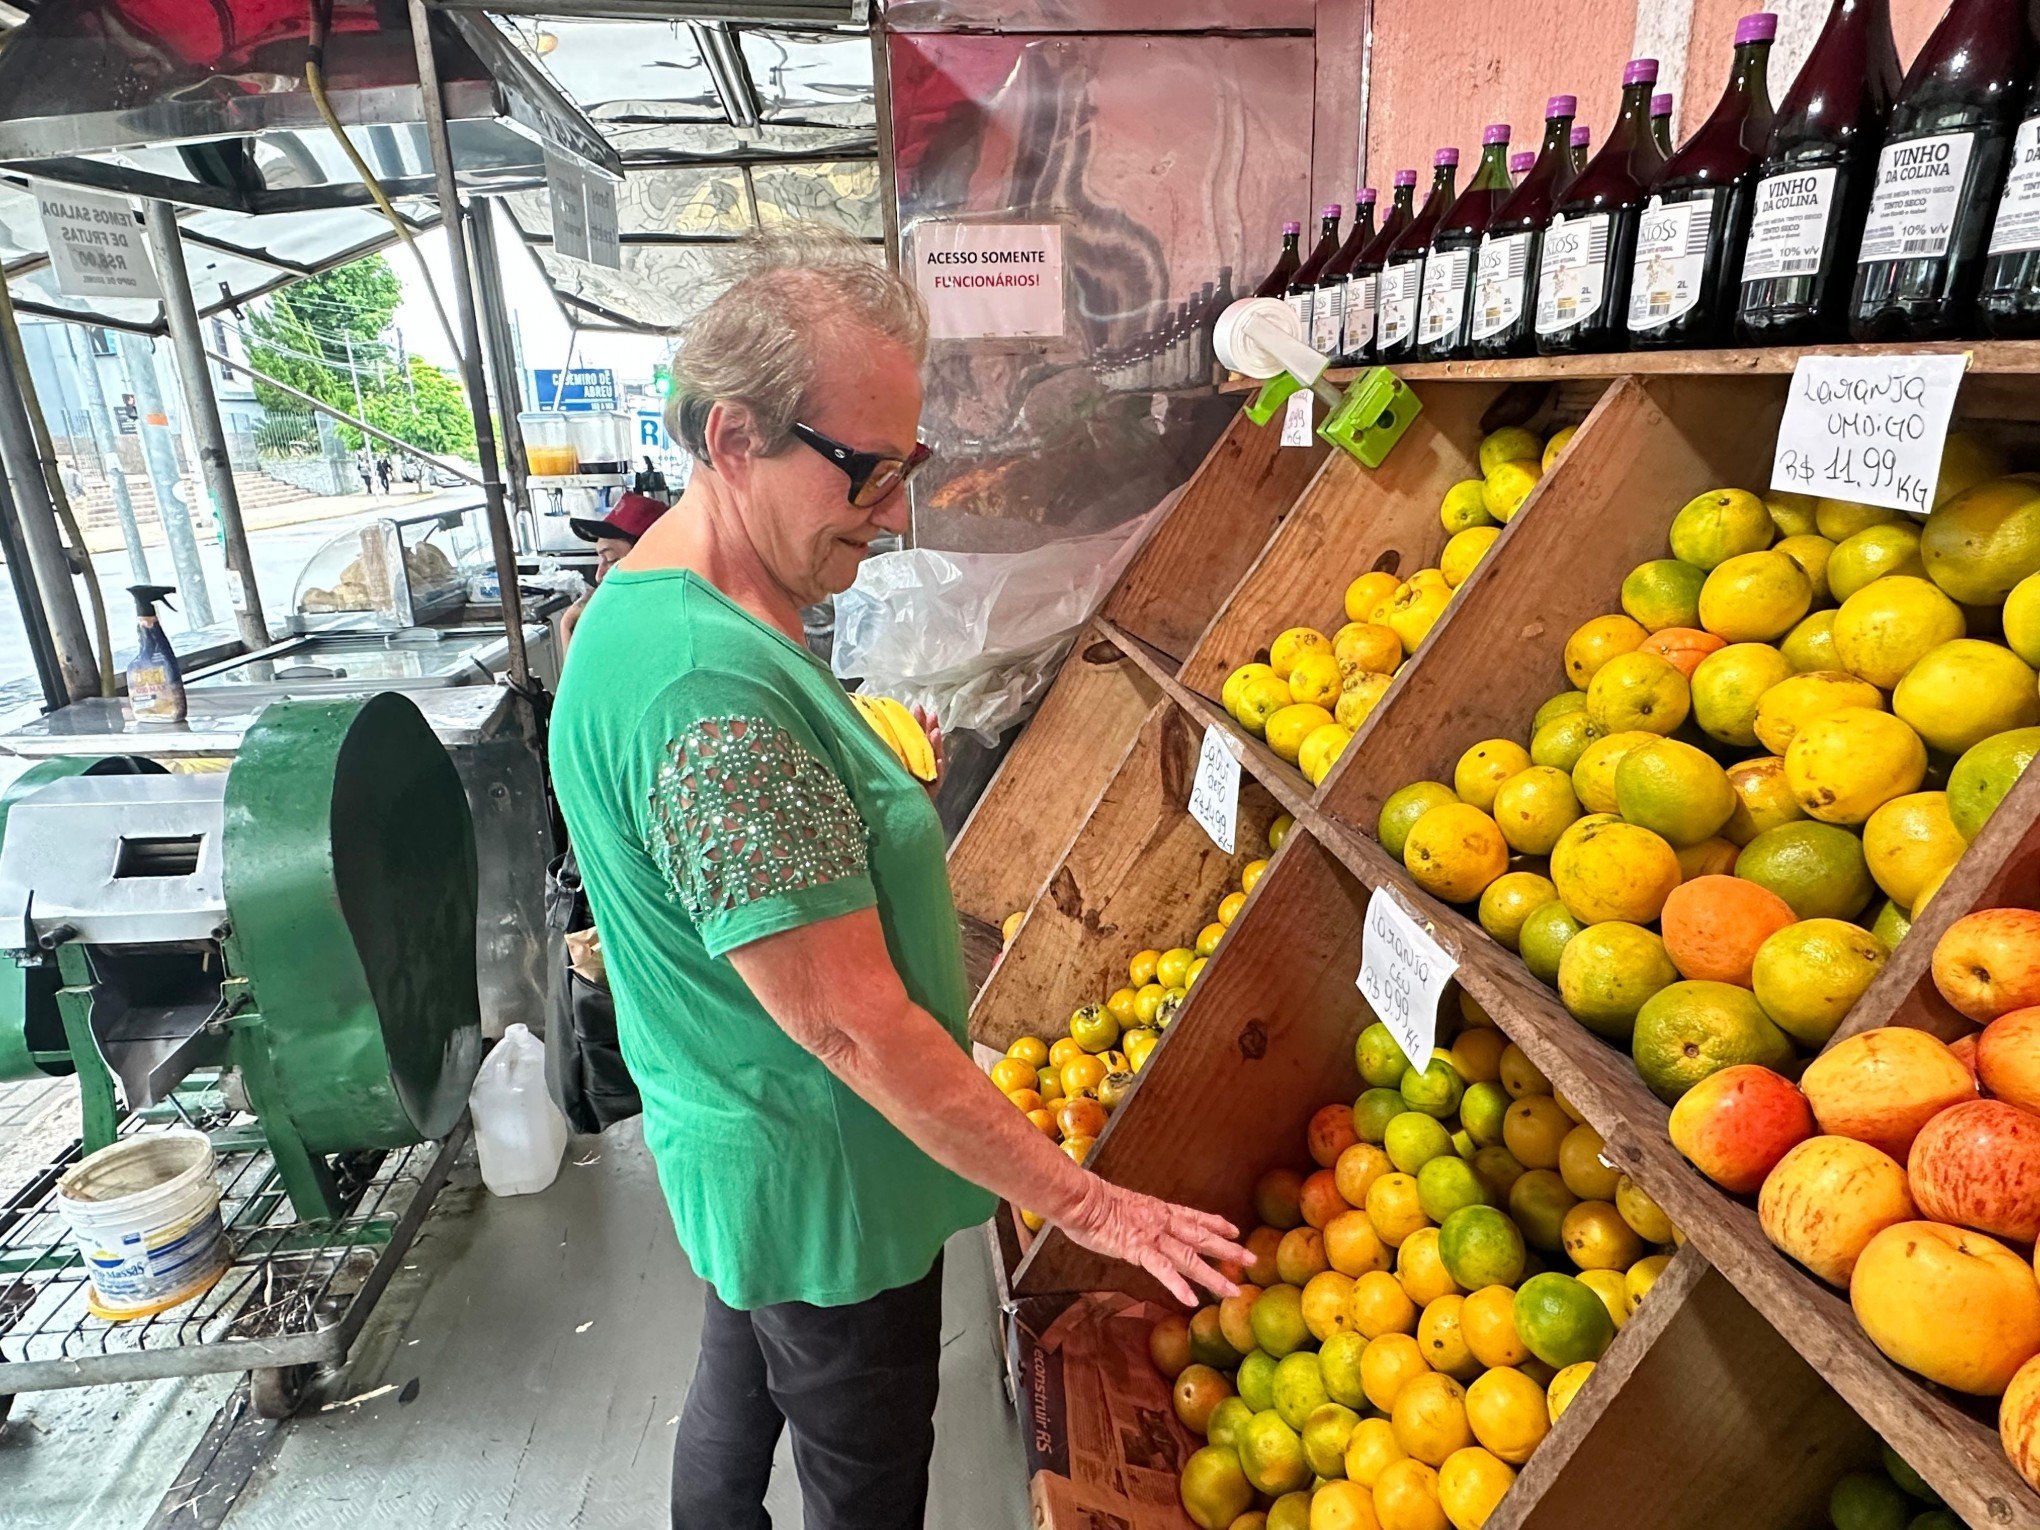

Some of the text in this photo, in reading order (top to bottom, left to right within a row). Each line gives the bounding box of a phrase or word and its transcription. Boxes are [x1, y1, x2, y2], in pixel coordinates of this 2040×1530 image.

[1894, 143, 1949, 167] VINHO
[1885, 163, 1950, 183] DA COLINA
[1769, 177, 1817, 198] VINHO
[1762, 194, 1818, 212] DA COLINA
[1902, 224, 1926, 236] 10%
[927, 250, 1045, 264] ACESSO SOMENTE
[1780, 247, 1800, 257] 10%
[934, 272, 1040, 288] FUNCIONÁRIOS!
[552, 373, 597, 386] CSEMIRO
[584, 385, 612, 398] ABREU
[1779, 449, 1815, 486] R$
[1897, 474, 1928, 511] KG
